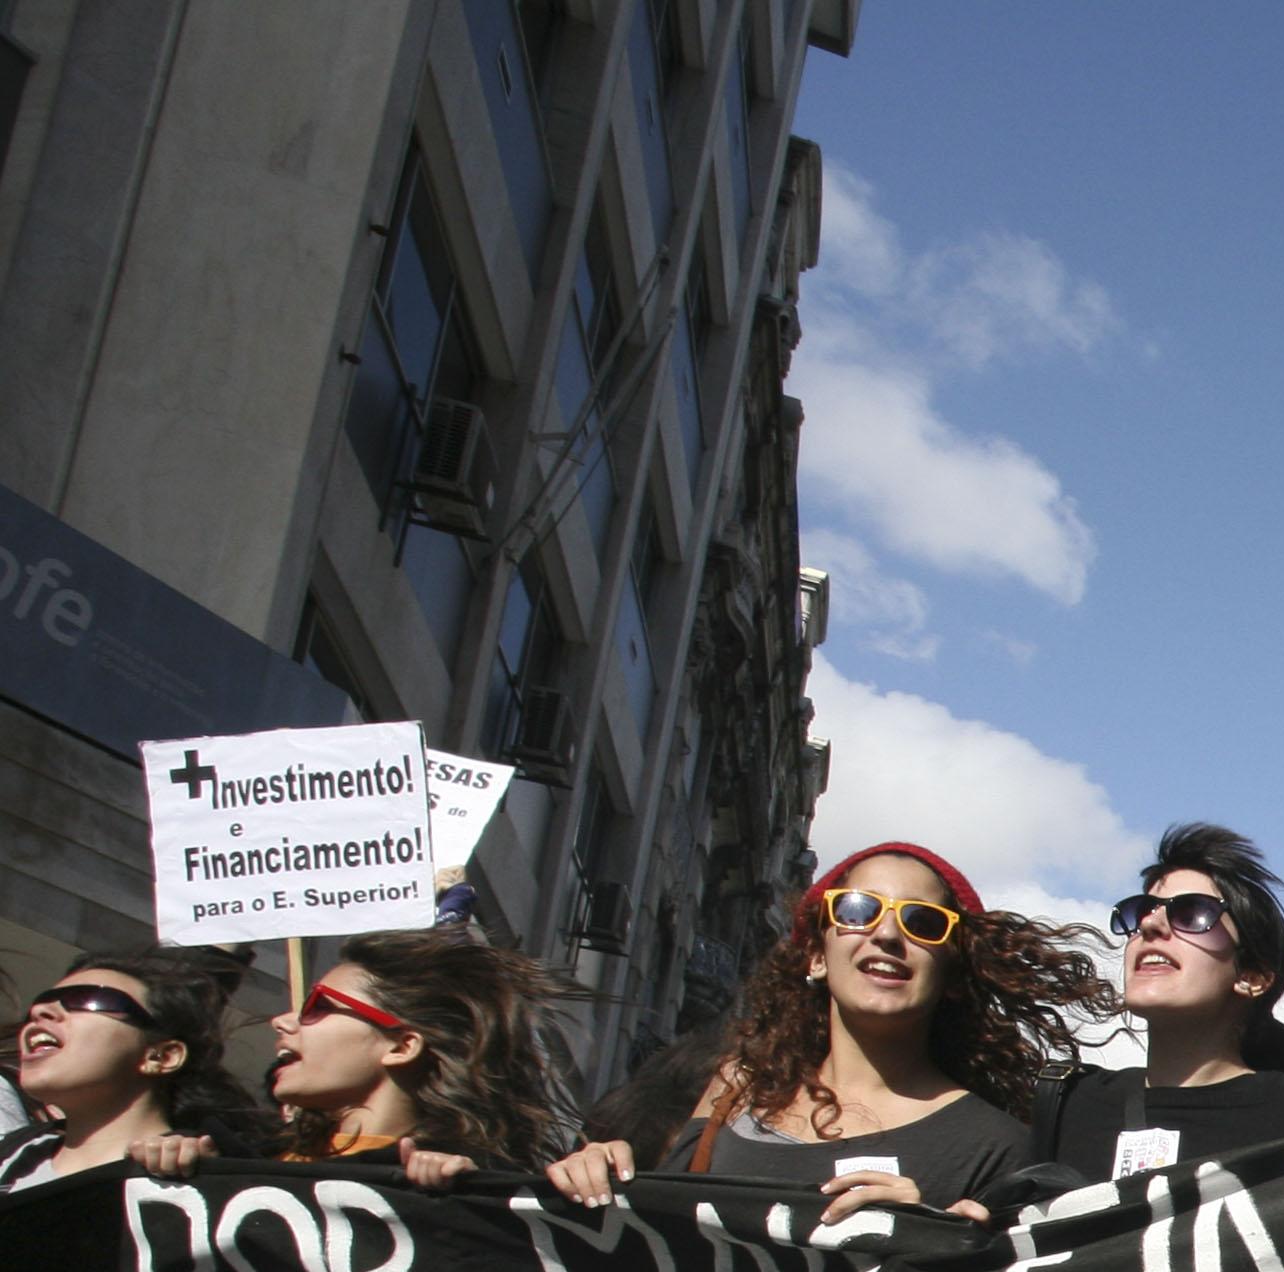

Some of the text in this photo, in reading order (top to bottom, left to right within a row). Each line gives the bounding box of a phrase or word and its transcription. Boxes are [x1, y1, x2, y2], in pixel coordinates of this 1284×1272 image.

[447, 807, 468, 818] de
[229, 823, 243, 837] e
[184, 827, 424, 882] Financiamento!
[193, 880, 419, 922] para o E. Superior!
